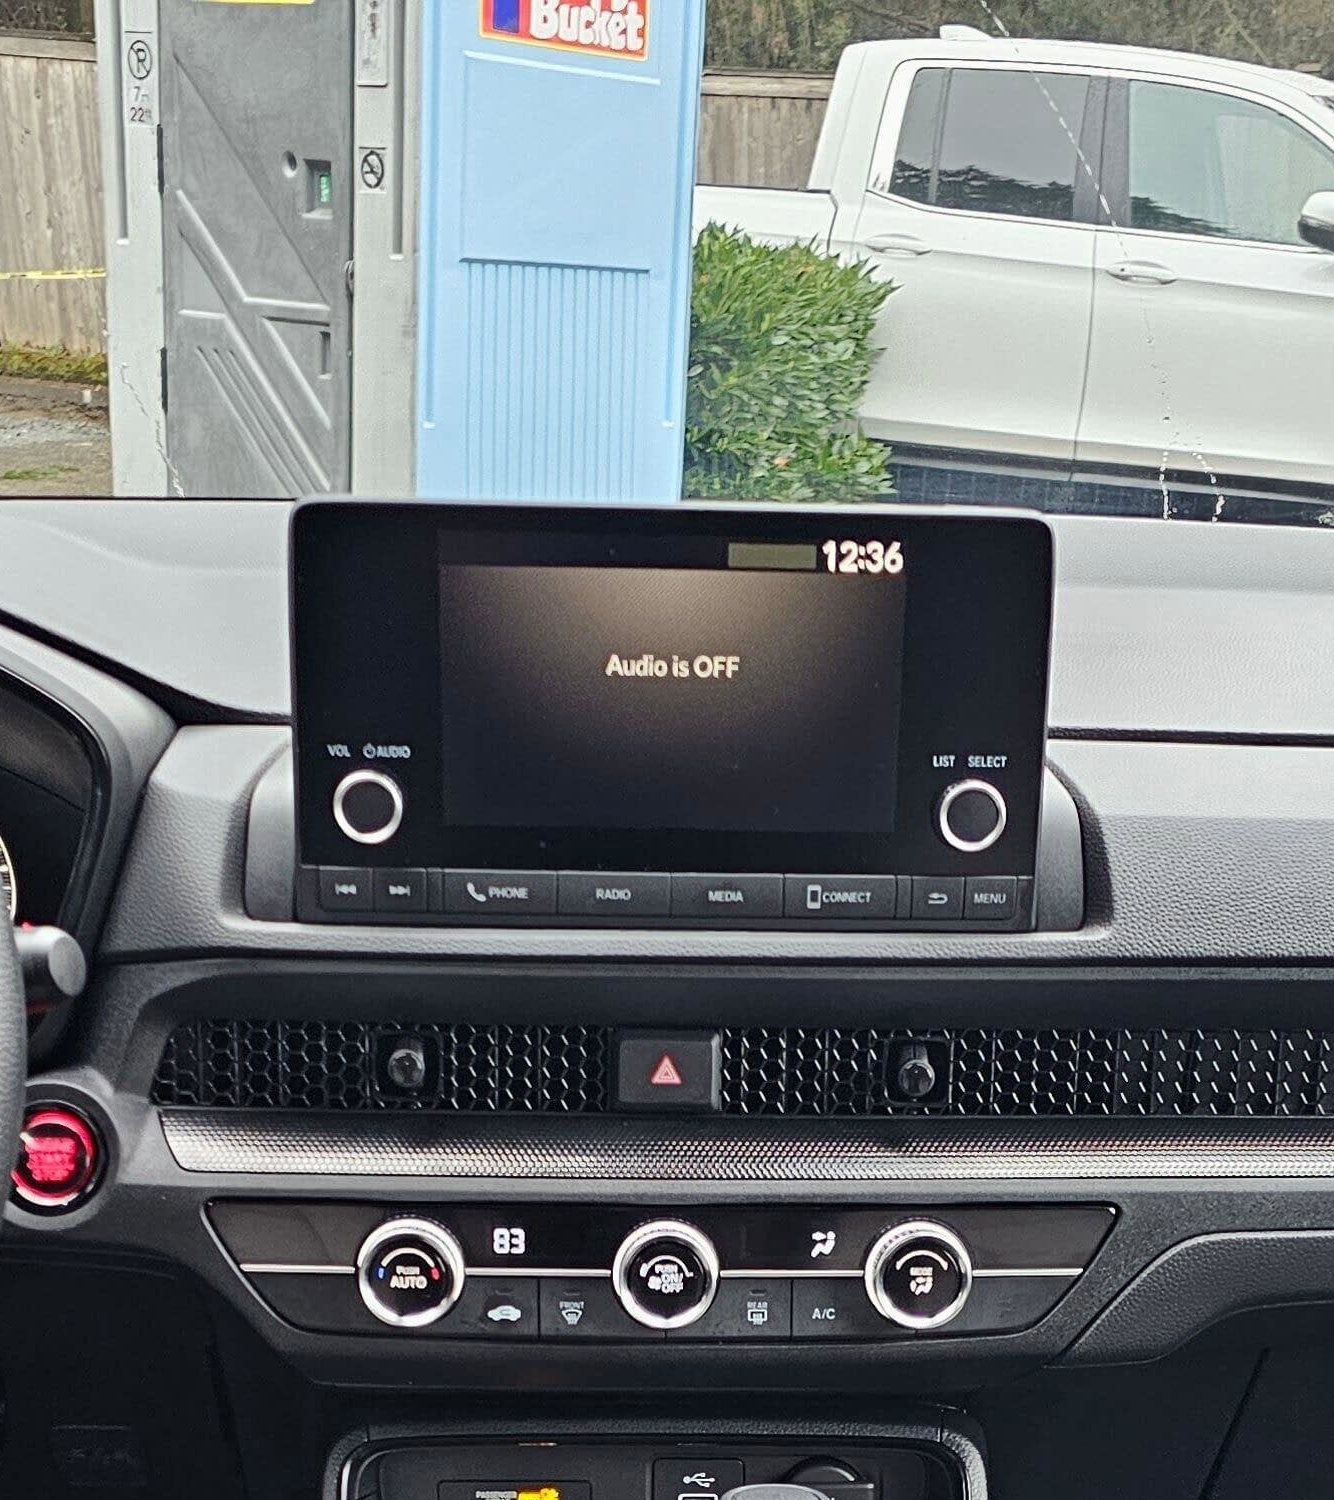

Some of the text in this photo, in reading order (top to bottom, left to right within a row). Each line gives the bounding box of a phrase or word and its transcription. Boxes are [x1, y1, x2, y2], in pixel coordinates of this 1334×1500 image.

[530, 0, 644, 50] Bucket
[821, 539, 905, 574] 12:36
[605, 653, 740, 679] Audio is OFF
[327, 744, 411, 758] VOL AUDIO
[932, 755, 1008, 768] LIST SELECT
[488, 886, 529, 899] PHONE
[596, 888, 631, 900] RADIO
[708, 890, 744, 902] MEDIA
[822, 892, 871, 903] CONNECT
[973, 893, 1007, 904] MENU
[493, 1227, 526, 1255] 83
[389, 1275, 428, 1290] AUTO
[660, 1281, 684, 1294] OFF
[559, 1300, 585, 1311] FRONT
[746, 1301, 768, 1311] REAR
[811, 1307, 836, 1320] A/C
